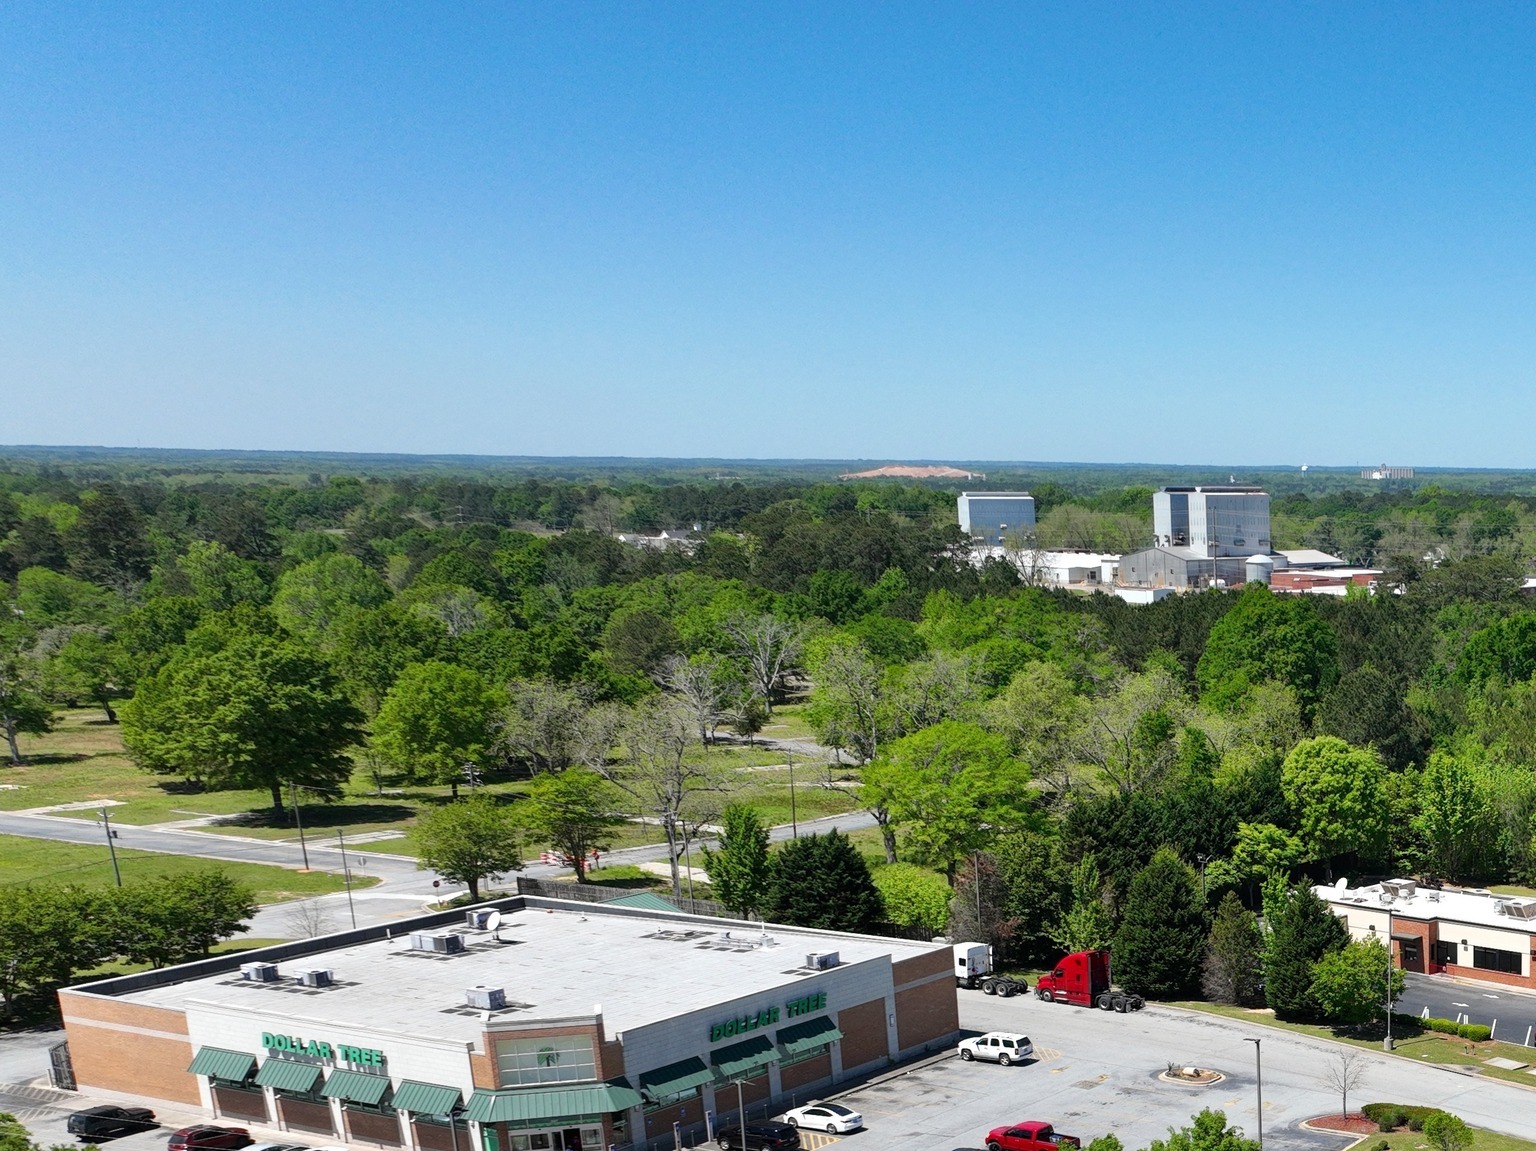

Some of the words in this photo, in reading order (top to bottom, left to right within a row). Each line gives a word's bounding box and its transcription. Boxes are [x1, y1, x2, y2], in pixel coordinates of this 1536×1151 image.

[711, 1006, 780, 1042] DOLLAR
[787, 992, 827, 1018] TREE
[262, 1031, 332, 1059] DOLLAR
[337, 1044, 383, 1067] TREE
